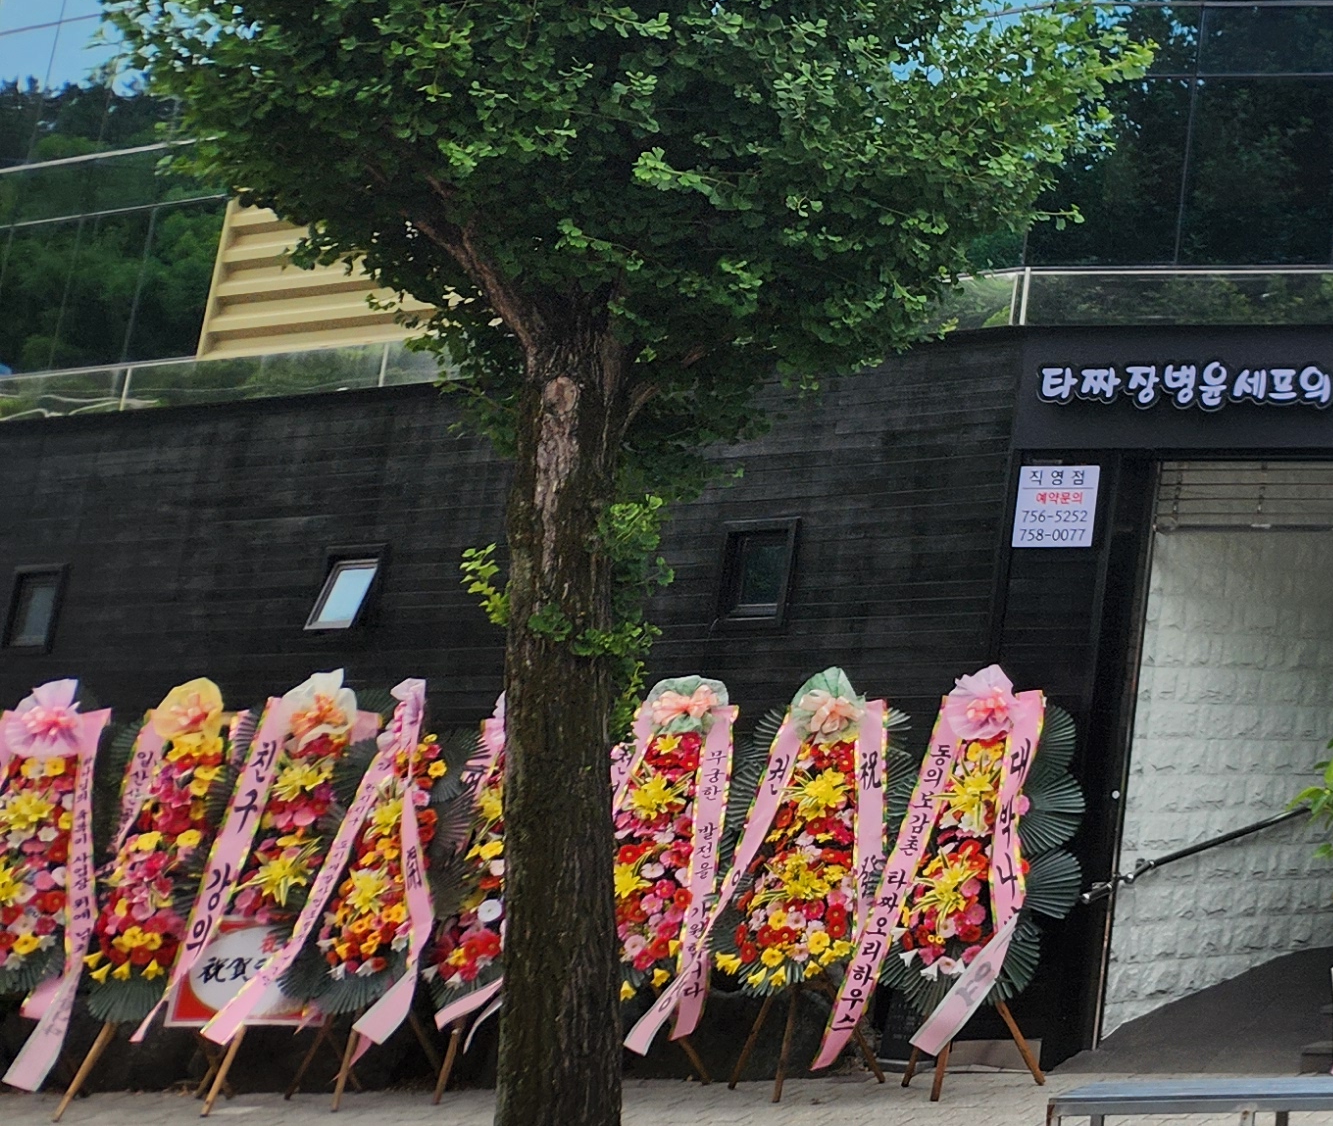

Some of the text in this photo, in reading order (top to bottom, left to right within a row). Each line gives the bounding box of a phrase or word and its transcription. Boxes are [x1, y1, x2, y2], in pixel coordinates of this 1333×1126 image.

[1030, 470, 1085, 486] 직영점
[1036, 492, 1083, 504] 예약문의
[1022, 510, 1088, 523] 756-5252
[1020, 529, 1086, 541] 758-0077
[703, 750, 726, 801] 무궁한
[899, 745, 951, 857] 동의보감촌
